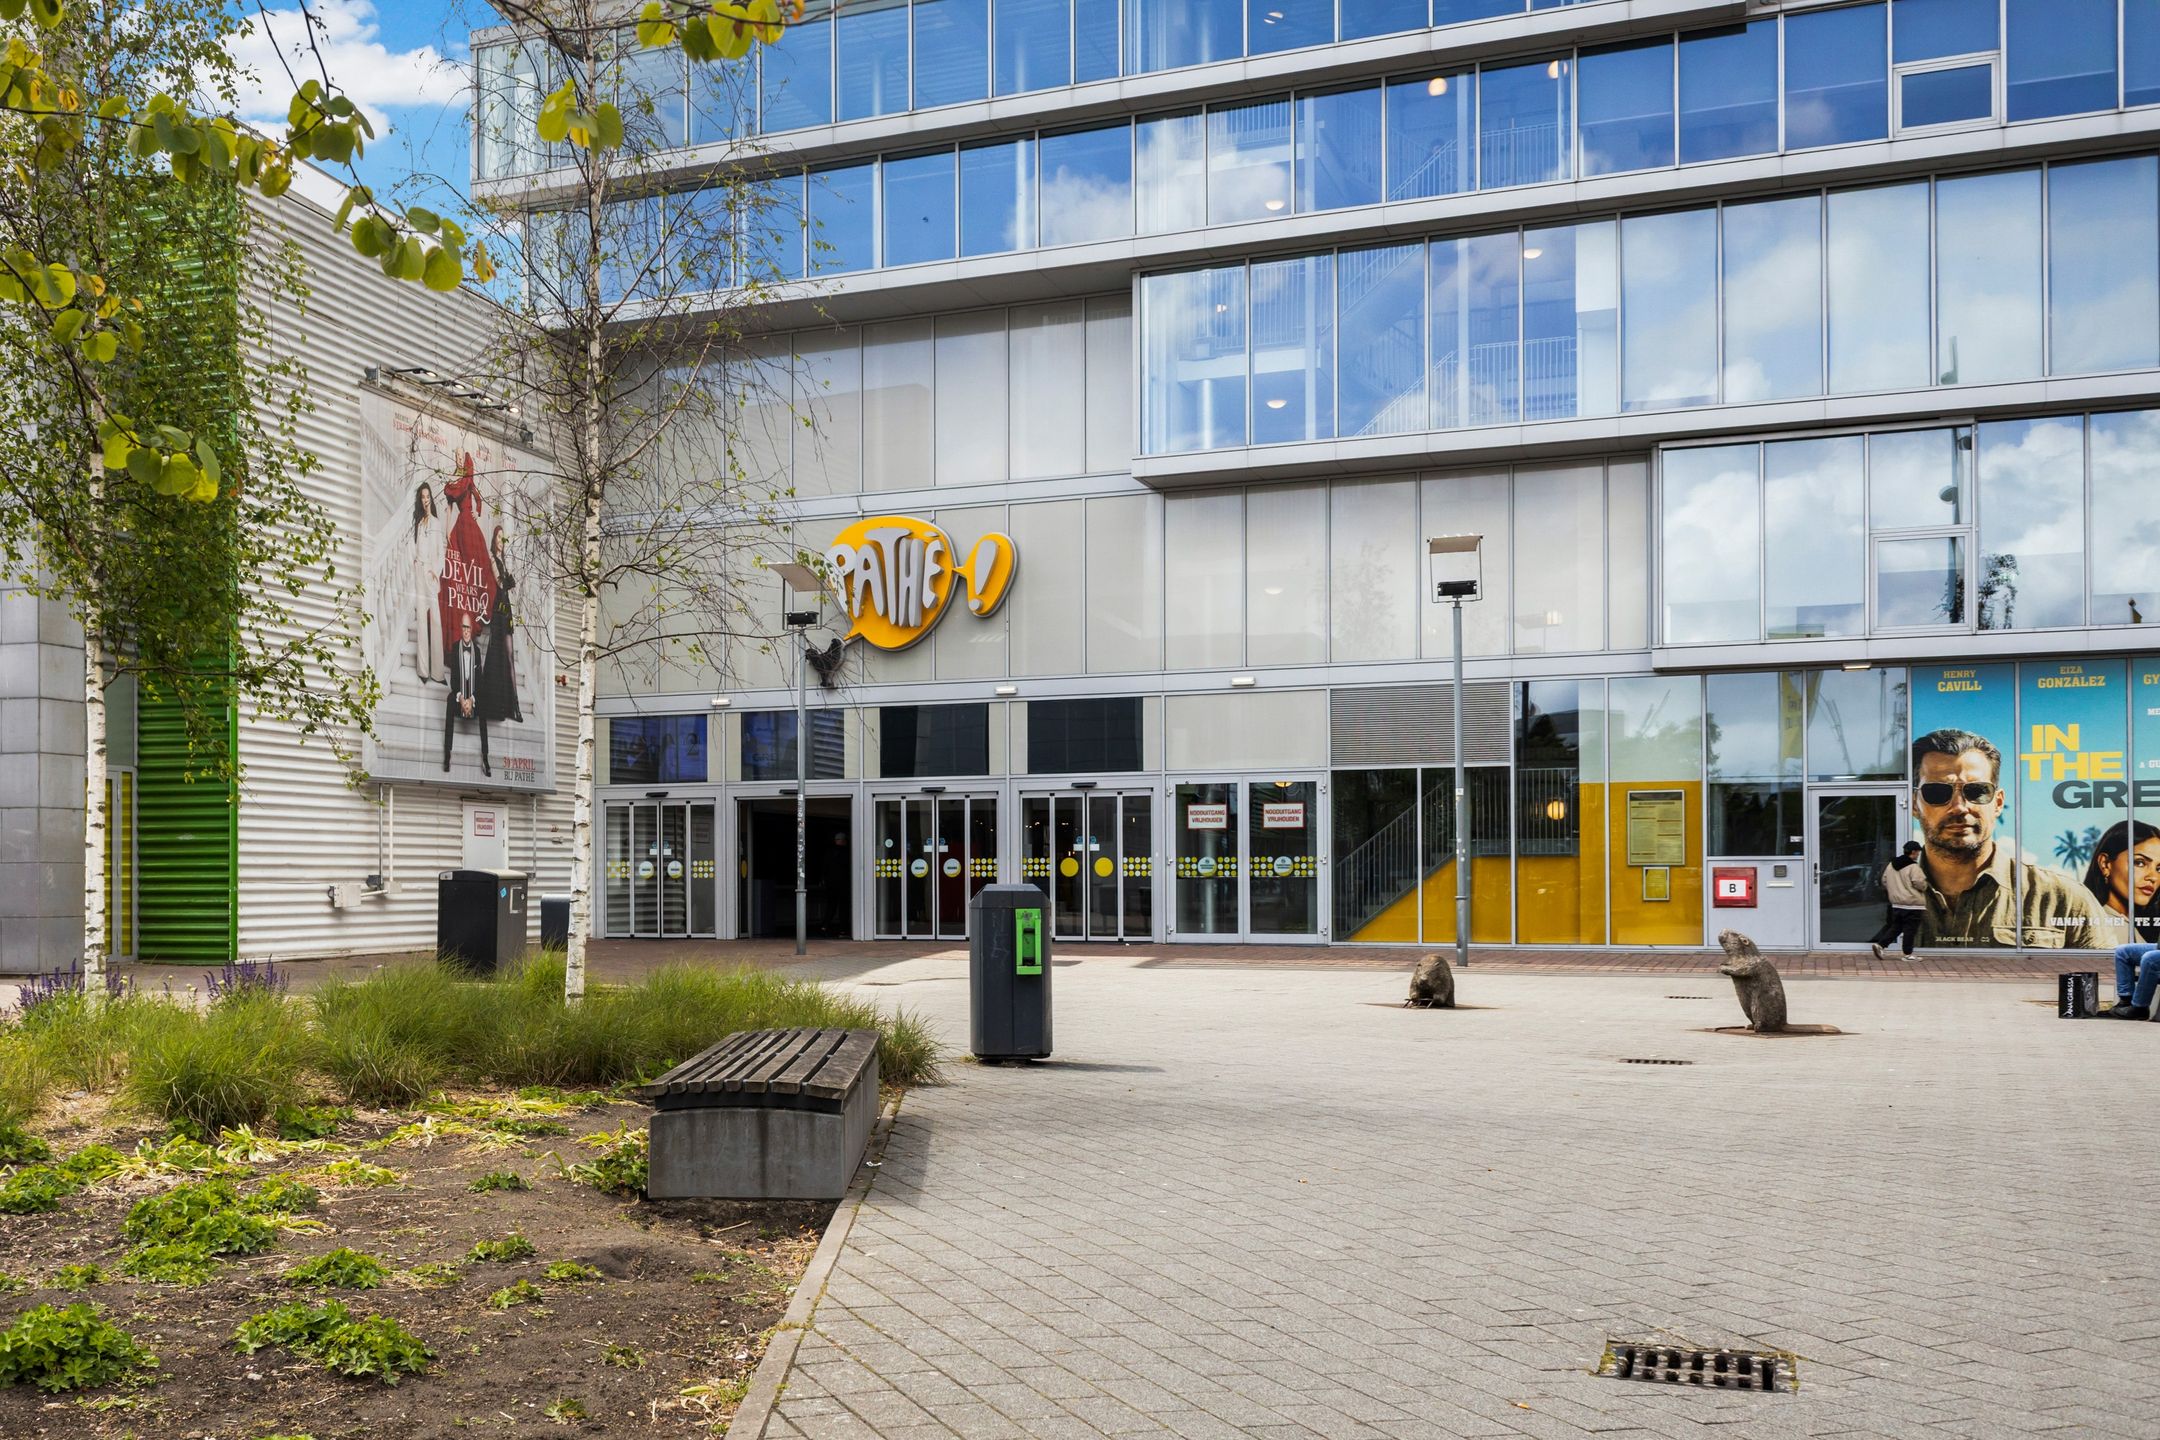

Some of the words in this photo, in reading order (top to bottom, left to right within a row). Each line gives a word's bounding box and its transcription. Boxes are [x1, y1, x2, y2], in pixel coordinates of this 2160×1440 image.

[447, 549, 461, 561] THE
[441, 558, 488, 589] DEVIL
[455, 583, 479, 596] WEARS
[1943, 670, 1976, 679] HENRY
[2059, 665, 2083, 675] EIZA
[1937, 680, 1982, 692] CAVILL
[2031, 723, 2079, 752] IN
[2020, 751, 2123, 781] THE
[2052, 780, 2160, 809] GRE
[1729, 883, 1736, 893] B
[2050, 916, 2086, 926] VANAF
[2104, 917, 2125, 926] MEI
[2134, 917, 2150, 927] TE
